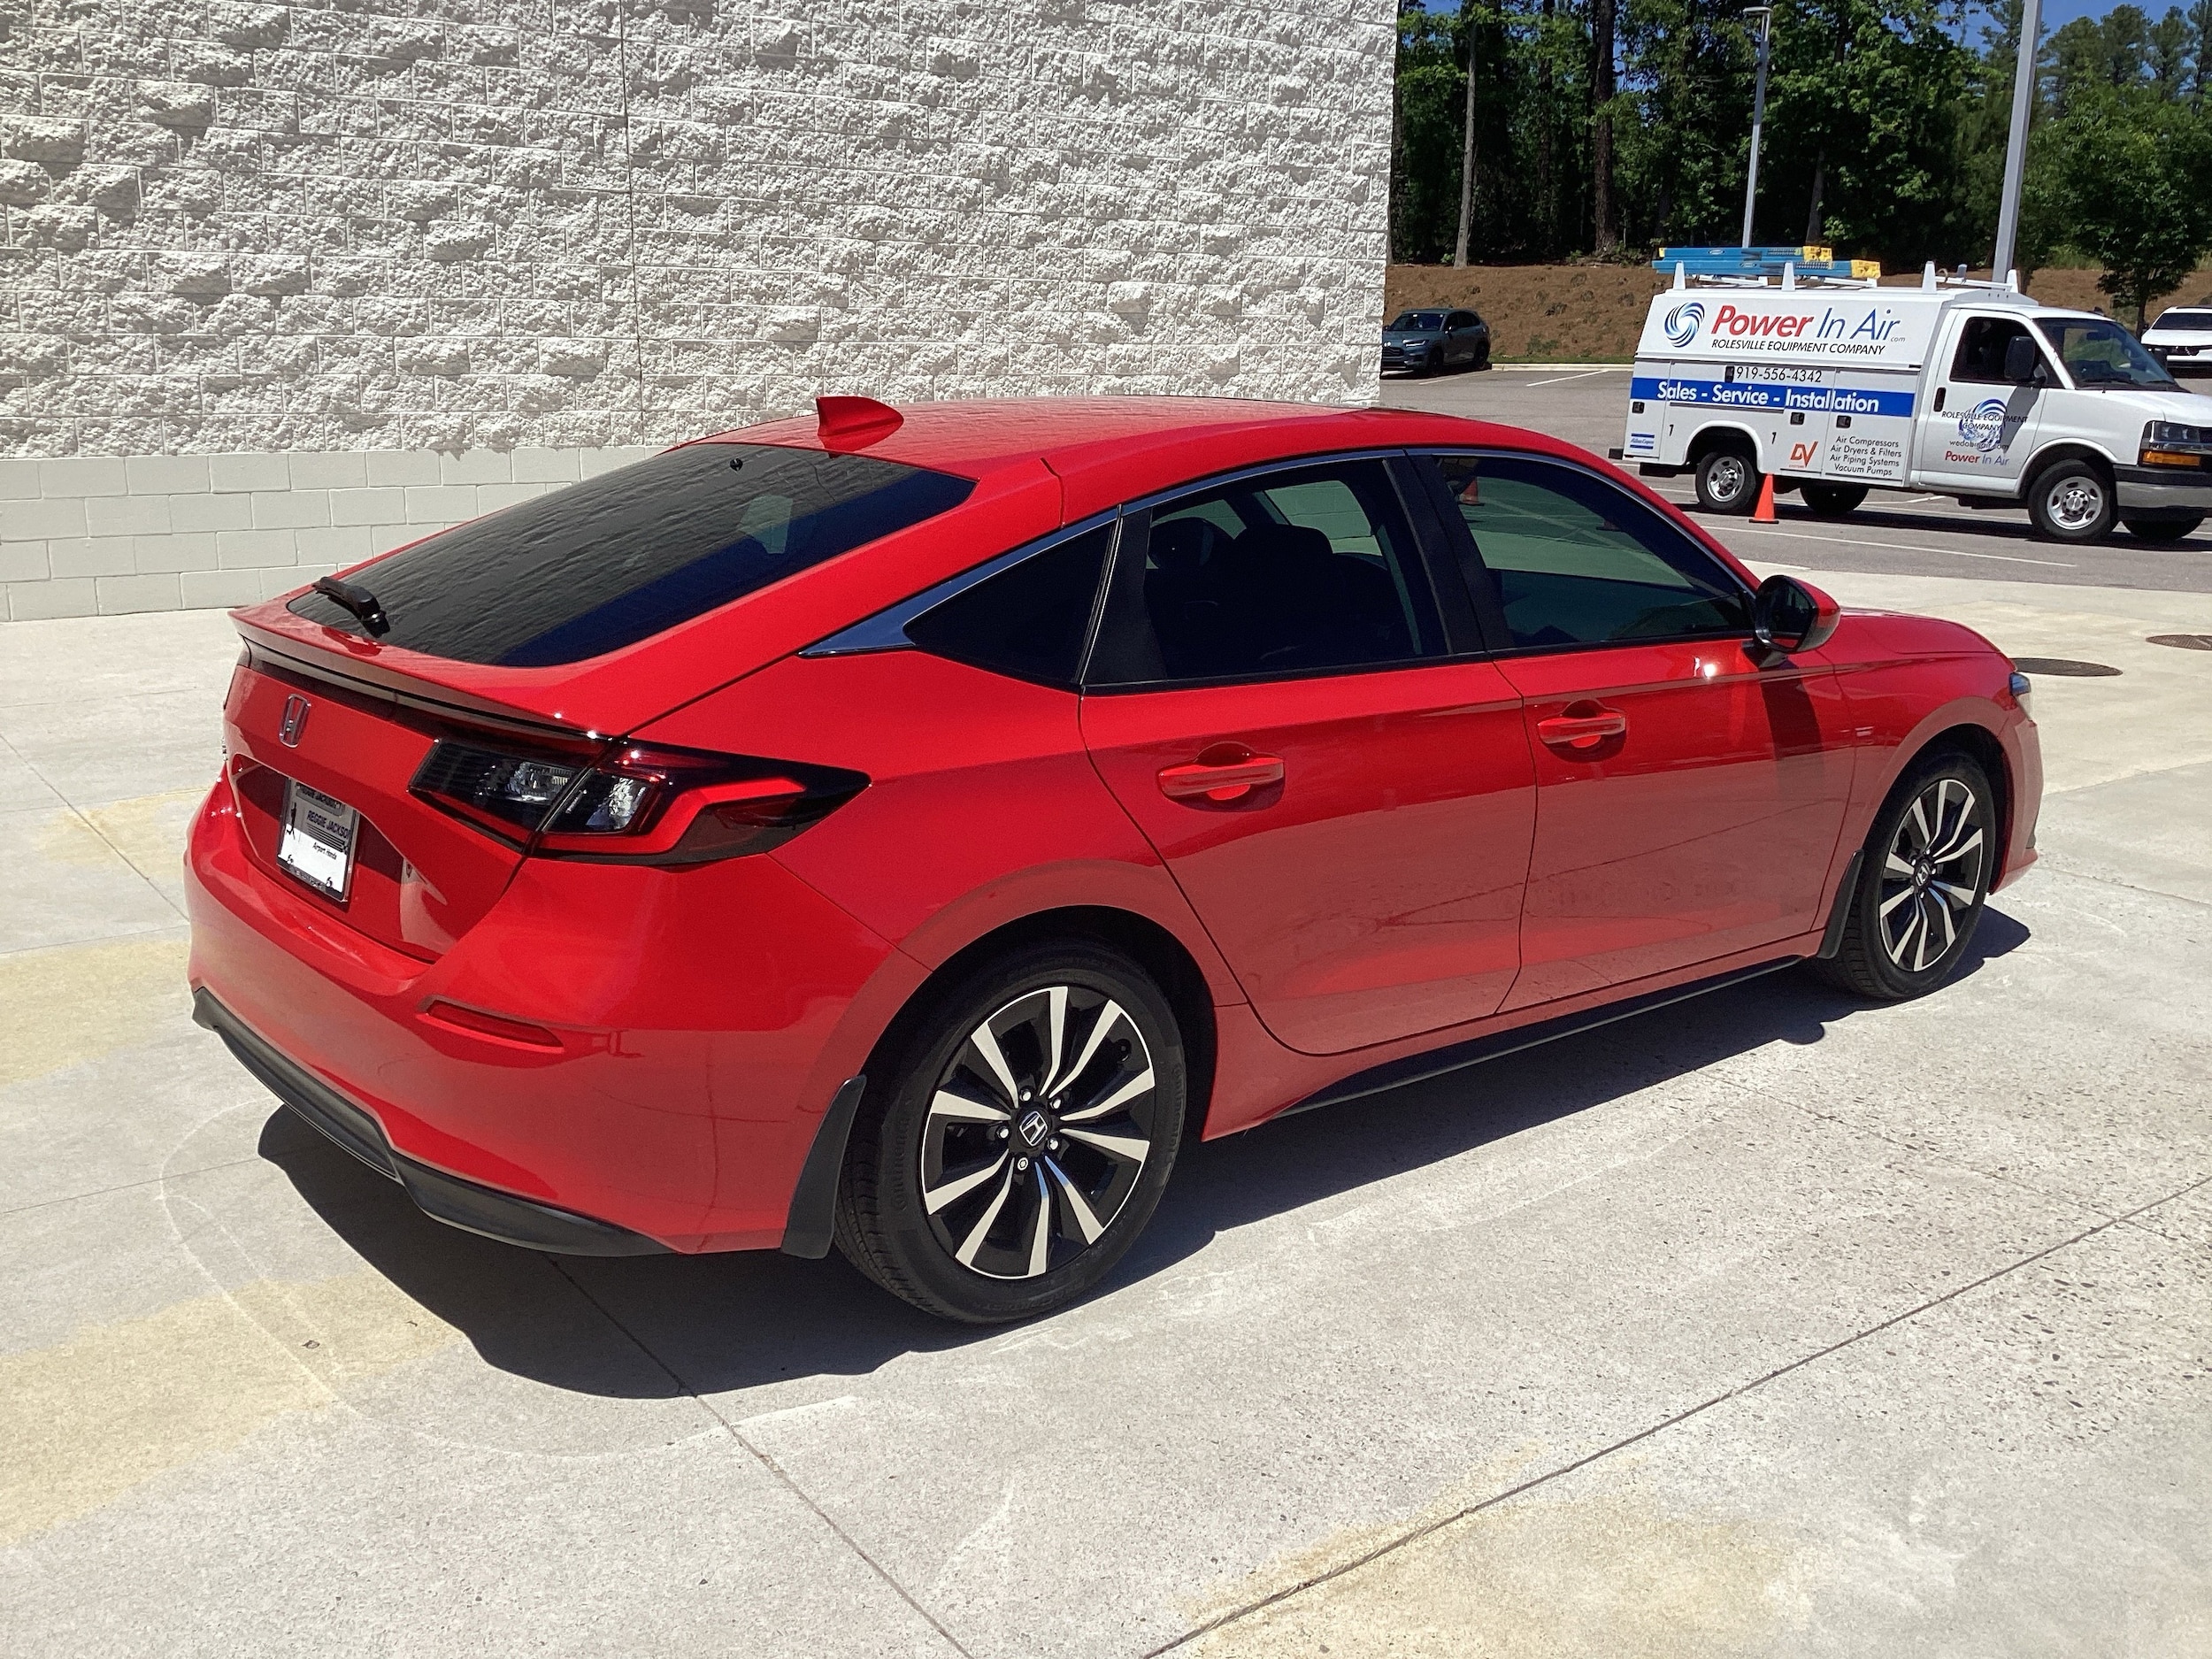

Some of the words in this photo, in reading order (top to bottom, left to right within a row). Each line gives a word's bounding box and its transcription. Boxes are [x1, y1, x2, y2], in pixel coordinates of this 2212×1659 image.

[1711, 305, 1814, 338] Power
[1816, 308, 1846, 339] In
[1849, 308, 1901, 341] Air
[1712, 339, 1765, 350] ROLESVILLE
[1767, 341, 1827, 353] EQUIPMENT
[1829, 343, 1886, 355] COMPANY
[1737, 366, 1823, 383] 919-556-4342
[1657, 381, 1697, 401] Sales
[1712, 384, 1769, 405] Service
[1786, 388, 1879, 413] Installation
[1941, 411, 1982, 420] ROLESVILLE
[1984, 413, 2028, 423] EQUIPMENT
[1669, 424, 1674, 436] 1
[1962, 422, 2002, 431] COMPANY
[1771, 432, 1777, 444] 1
[1849, 436, 1899, 448] Compressors
[1843, 446, 1869, 456] Dryers
[1878, 448, 1901, 457] Filters
[1945, 450, 1980, 463] Power
[1982, 454, 1992, 465] In
[1993, 455, 2009, 465] Air
[1843, 455, 1867, 466] Piping
[1869, 457, 1900, 467] Systems
[1834, 463, 1864, 473] Vacuum
[1866, 465, 1893, 476] Pumps
